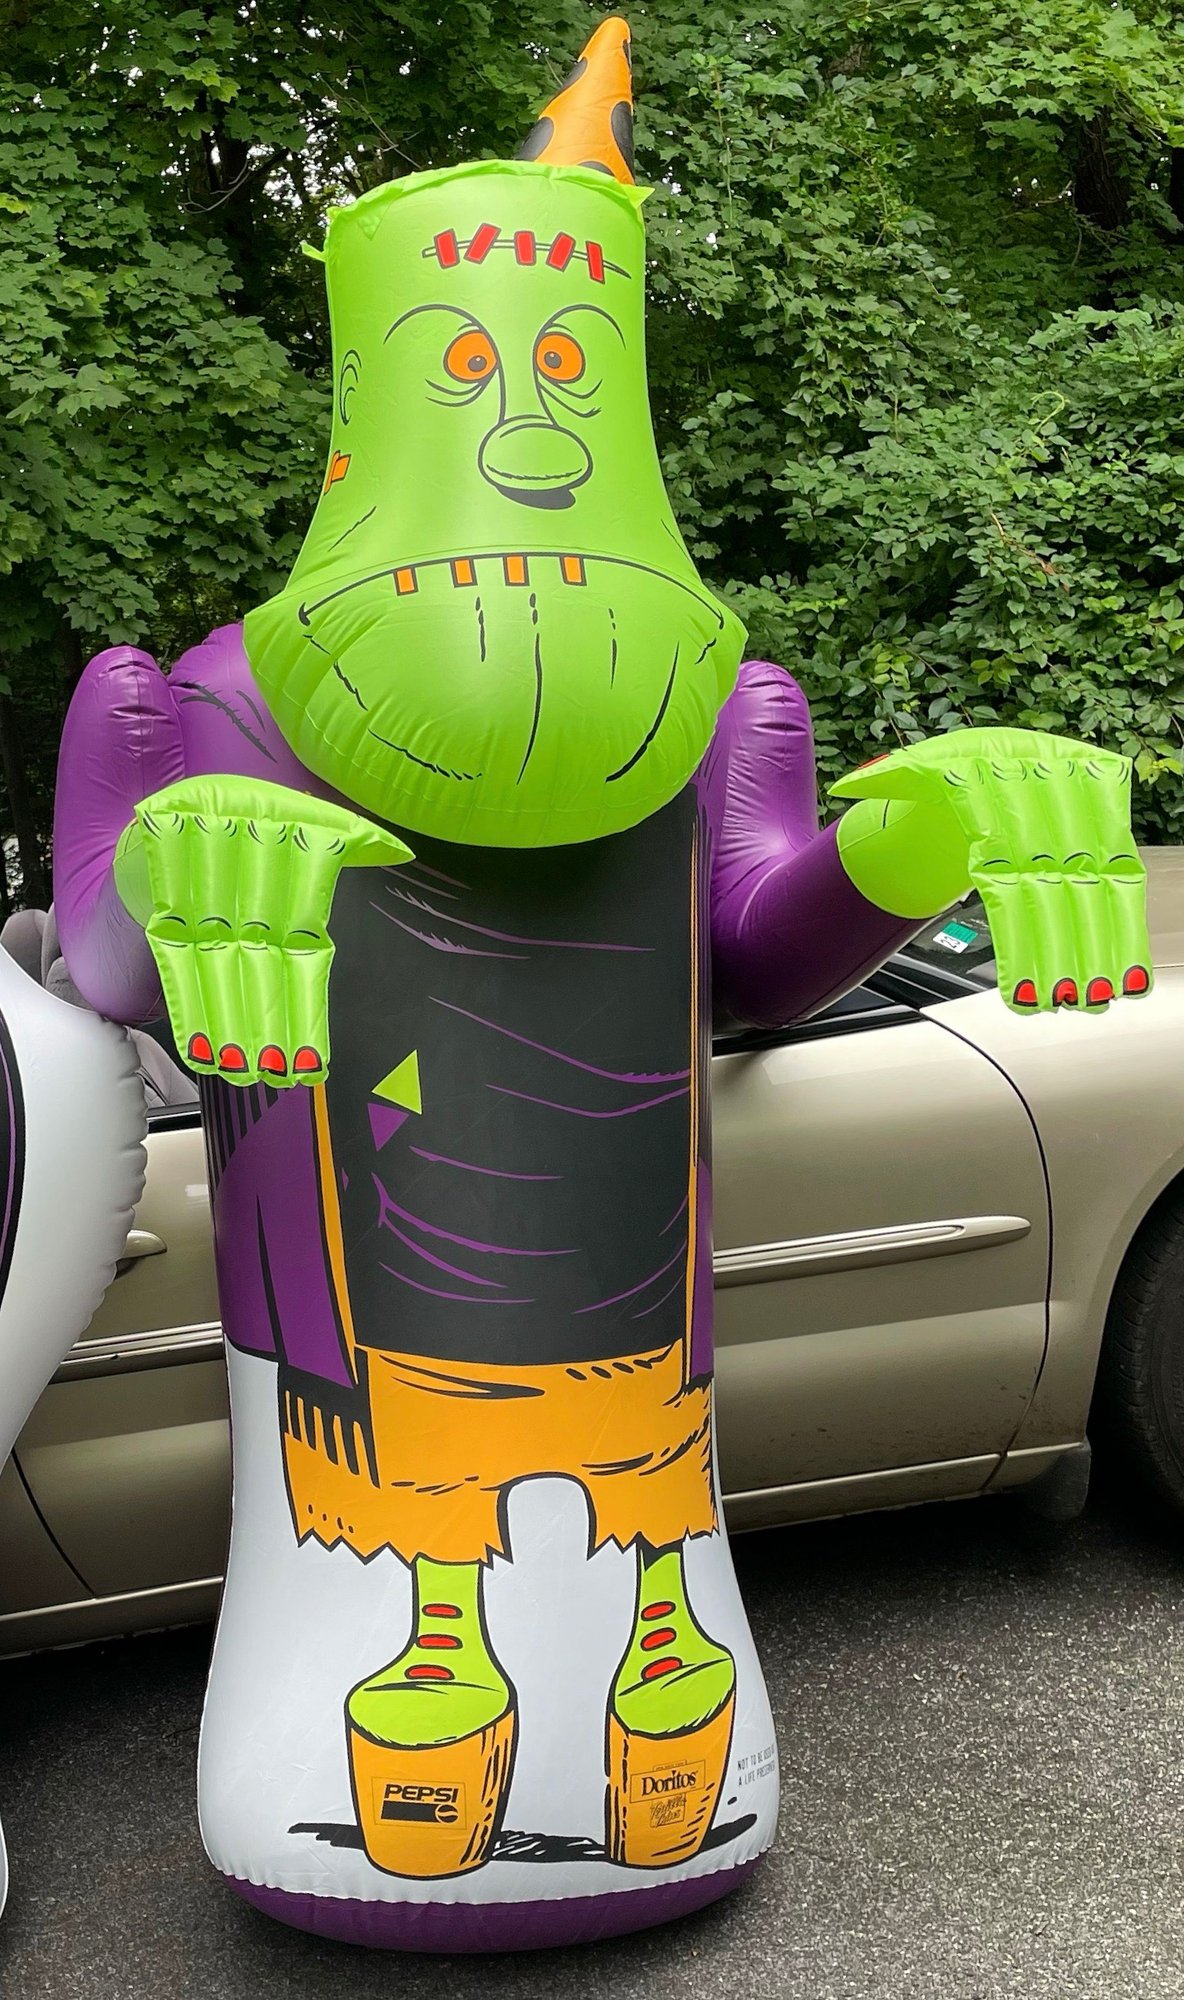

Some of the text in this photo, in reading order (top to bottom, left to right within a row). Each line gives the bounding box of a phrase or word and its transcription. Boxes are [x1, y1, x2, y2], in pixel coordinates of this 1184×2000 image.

[737, 1757, 749, 1771] NOT
[750, 1754, 757, 1766] TO
[757, 1751, 764, 1763] BE
[641, 1769, 697, 1797] Doritos
[738, 1775, 743, 1786] A
[744, 1769, 756, 1785] LIFE
[384, 1784, 458, 1803] PEPSI
